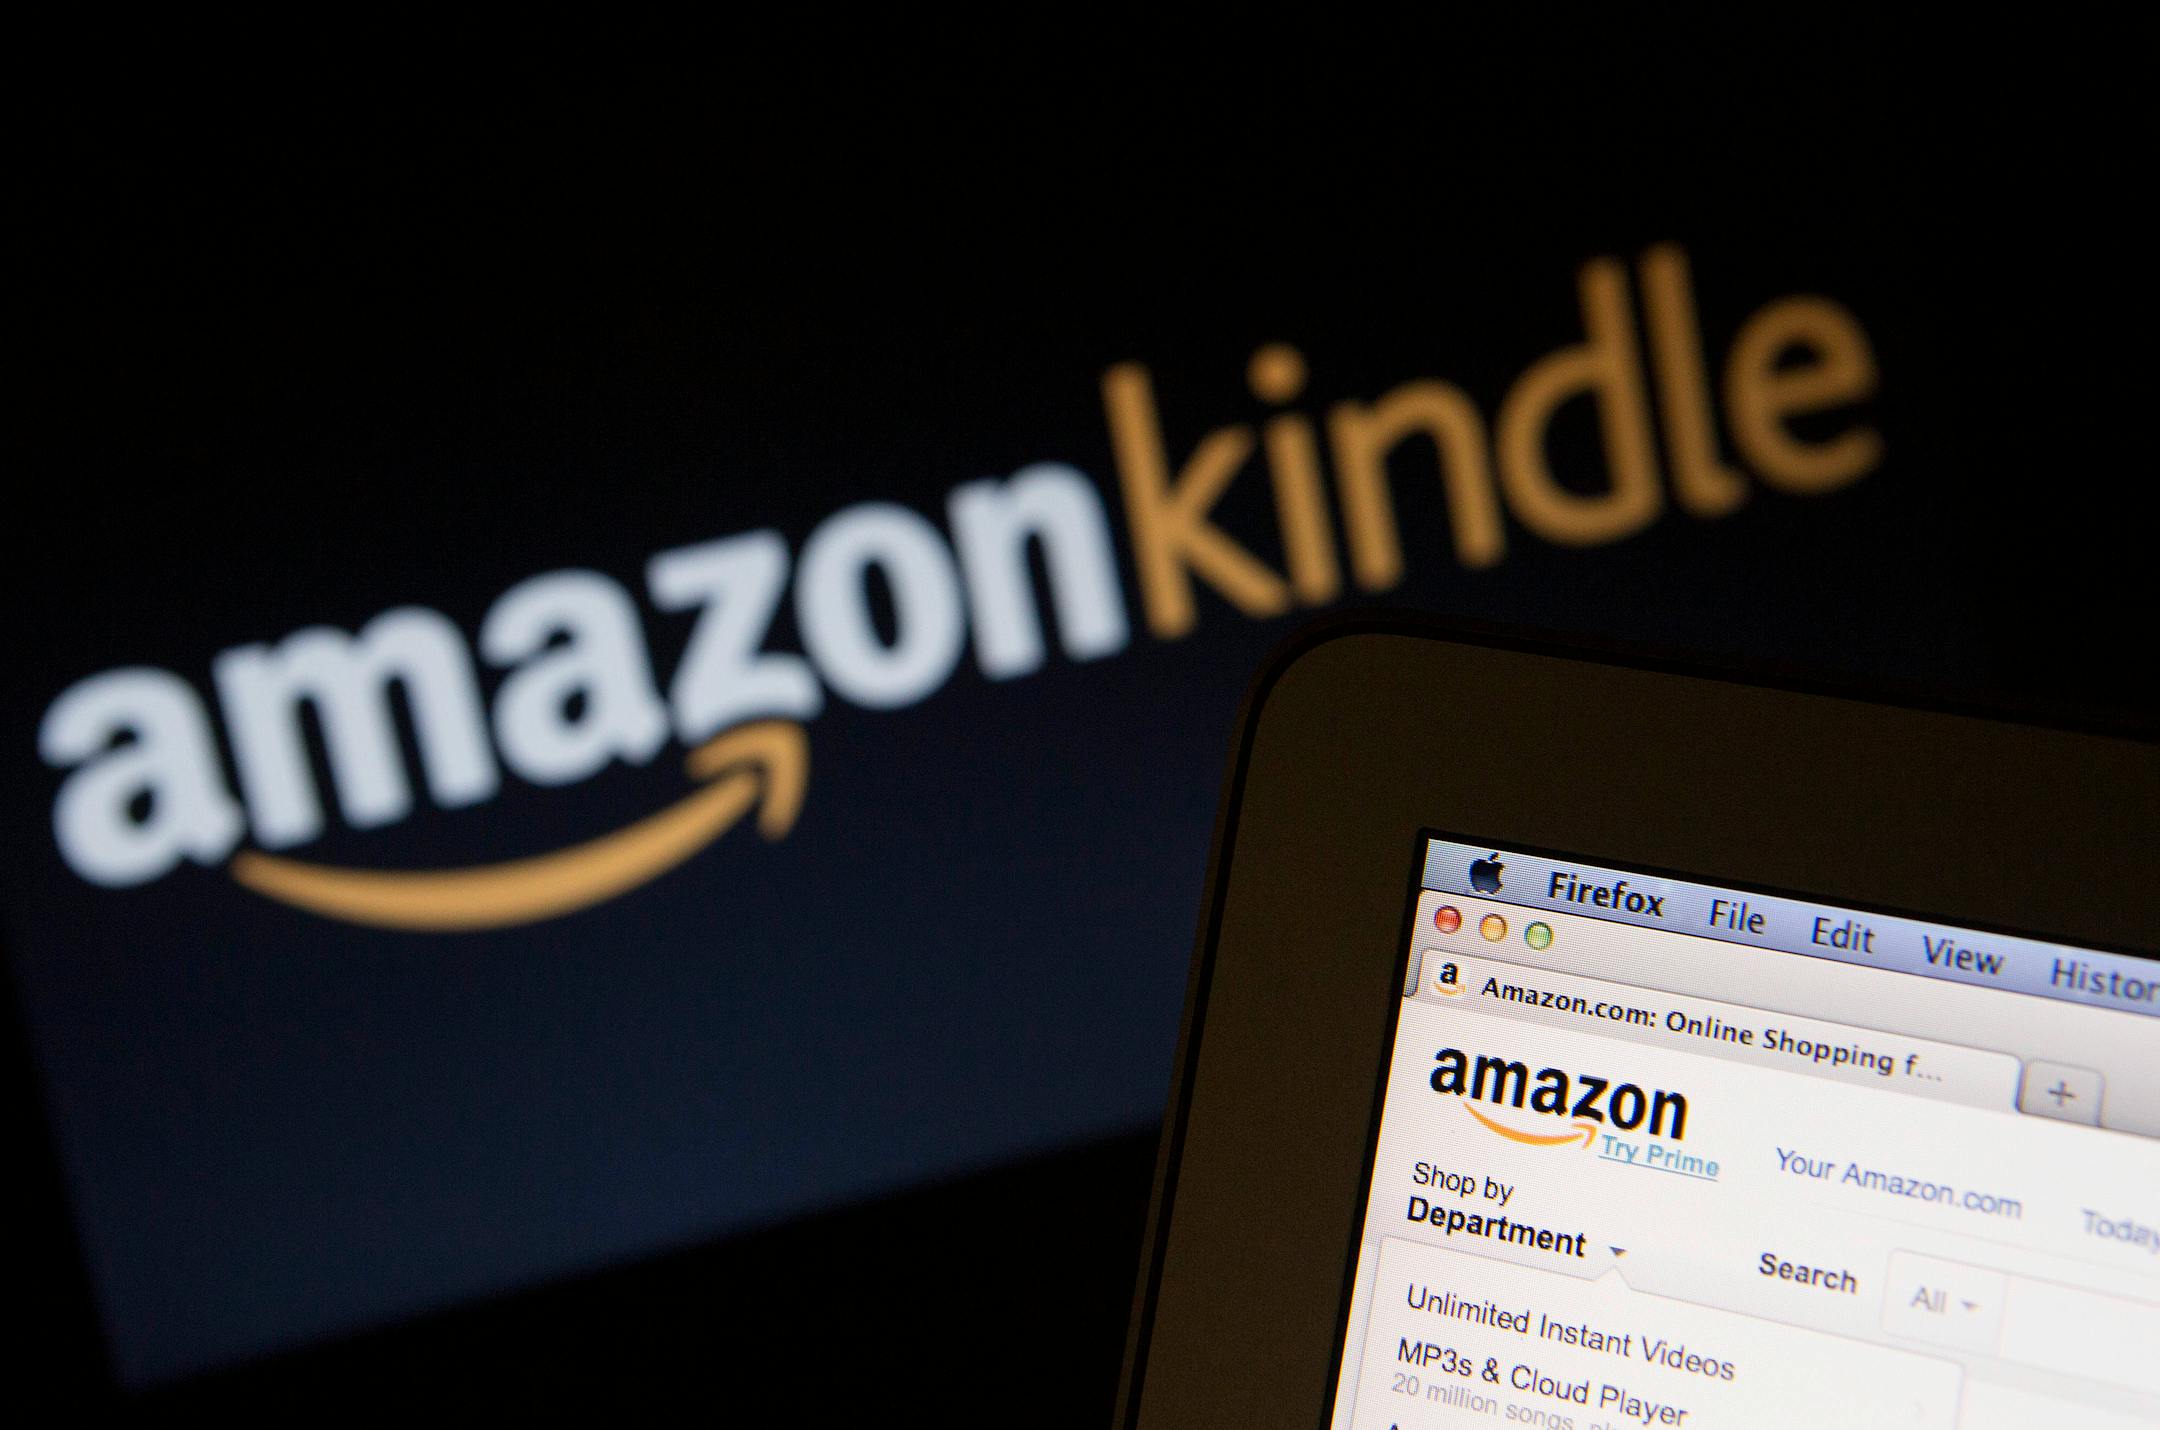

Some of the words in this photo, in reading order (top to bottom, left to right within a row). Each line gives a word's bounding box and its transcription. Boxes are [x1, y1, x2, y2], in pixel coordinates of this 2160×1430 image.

[1547, 871, 1664, 918] Firefox
[1710, 898, 1766, 935] File
[1811, 917, 1876, 954] Edit
[1922, 935, 2006, 975] View
[2051, 957, 2160, 1002] Histor
[1439, 963, 1459, 985] a
[1481, 977, 1657, 1028] Amazon.com:
[1666, 1010, 1753, 1046] Online
[1763, 1028, 1893, 1077] Shopping
[1430, 1047, 1688, 1140] amazon
[1413, 1162, 1475, 1196] Shop
[1484, 1175, 1514, 1206] by
[1602, 1134, 1640, 1163] Try
[1647, 1146, 1719, 1178] Prime
[1776, 1147, 1834, 1180] Your
[1842, 1163, 2023, 1219] Amazon.com
[1407, 1196, 1587, 1258] Department
[1759, 1252, 1858, 1294] Search
[1911, 1286, 1947, 1314] All
[1408, 1283, 1530, 1334] Unlimited
[1540, 1313, 1632, 1358] Instant
[1642, 1335, 1736, 1381] Videos
[1392, 1372, 1420, 1397] 20
[1427, 1381, 1498, 1417] million
[1398, 1337, 1472, 1377] MP3s
[1482, 1357, 1500, 1384] &
[1511, 1364, 1589, 1405] Cloud
[1600, 1384, 1689, 1427] Player
